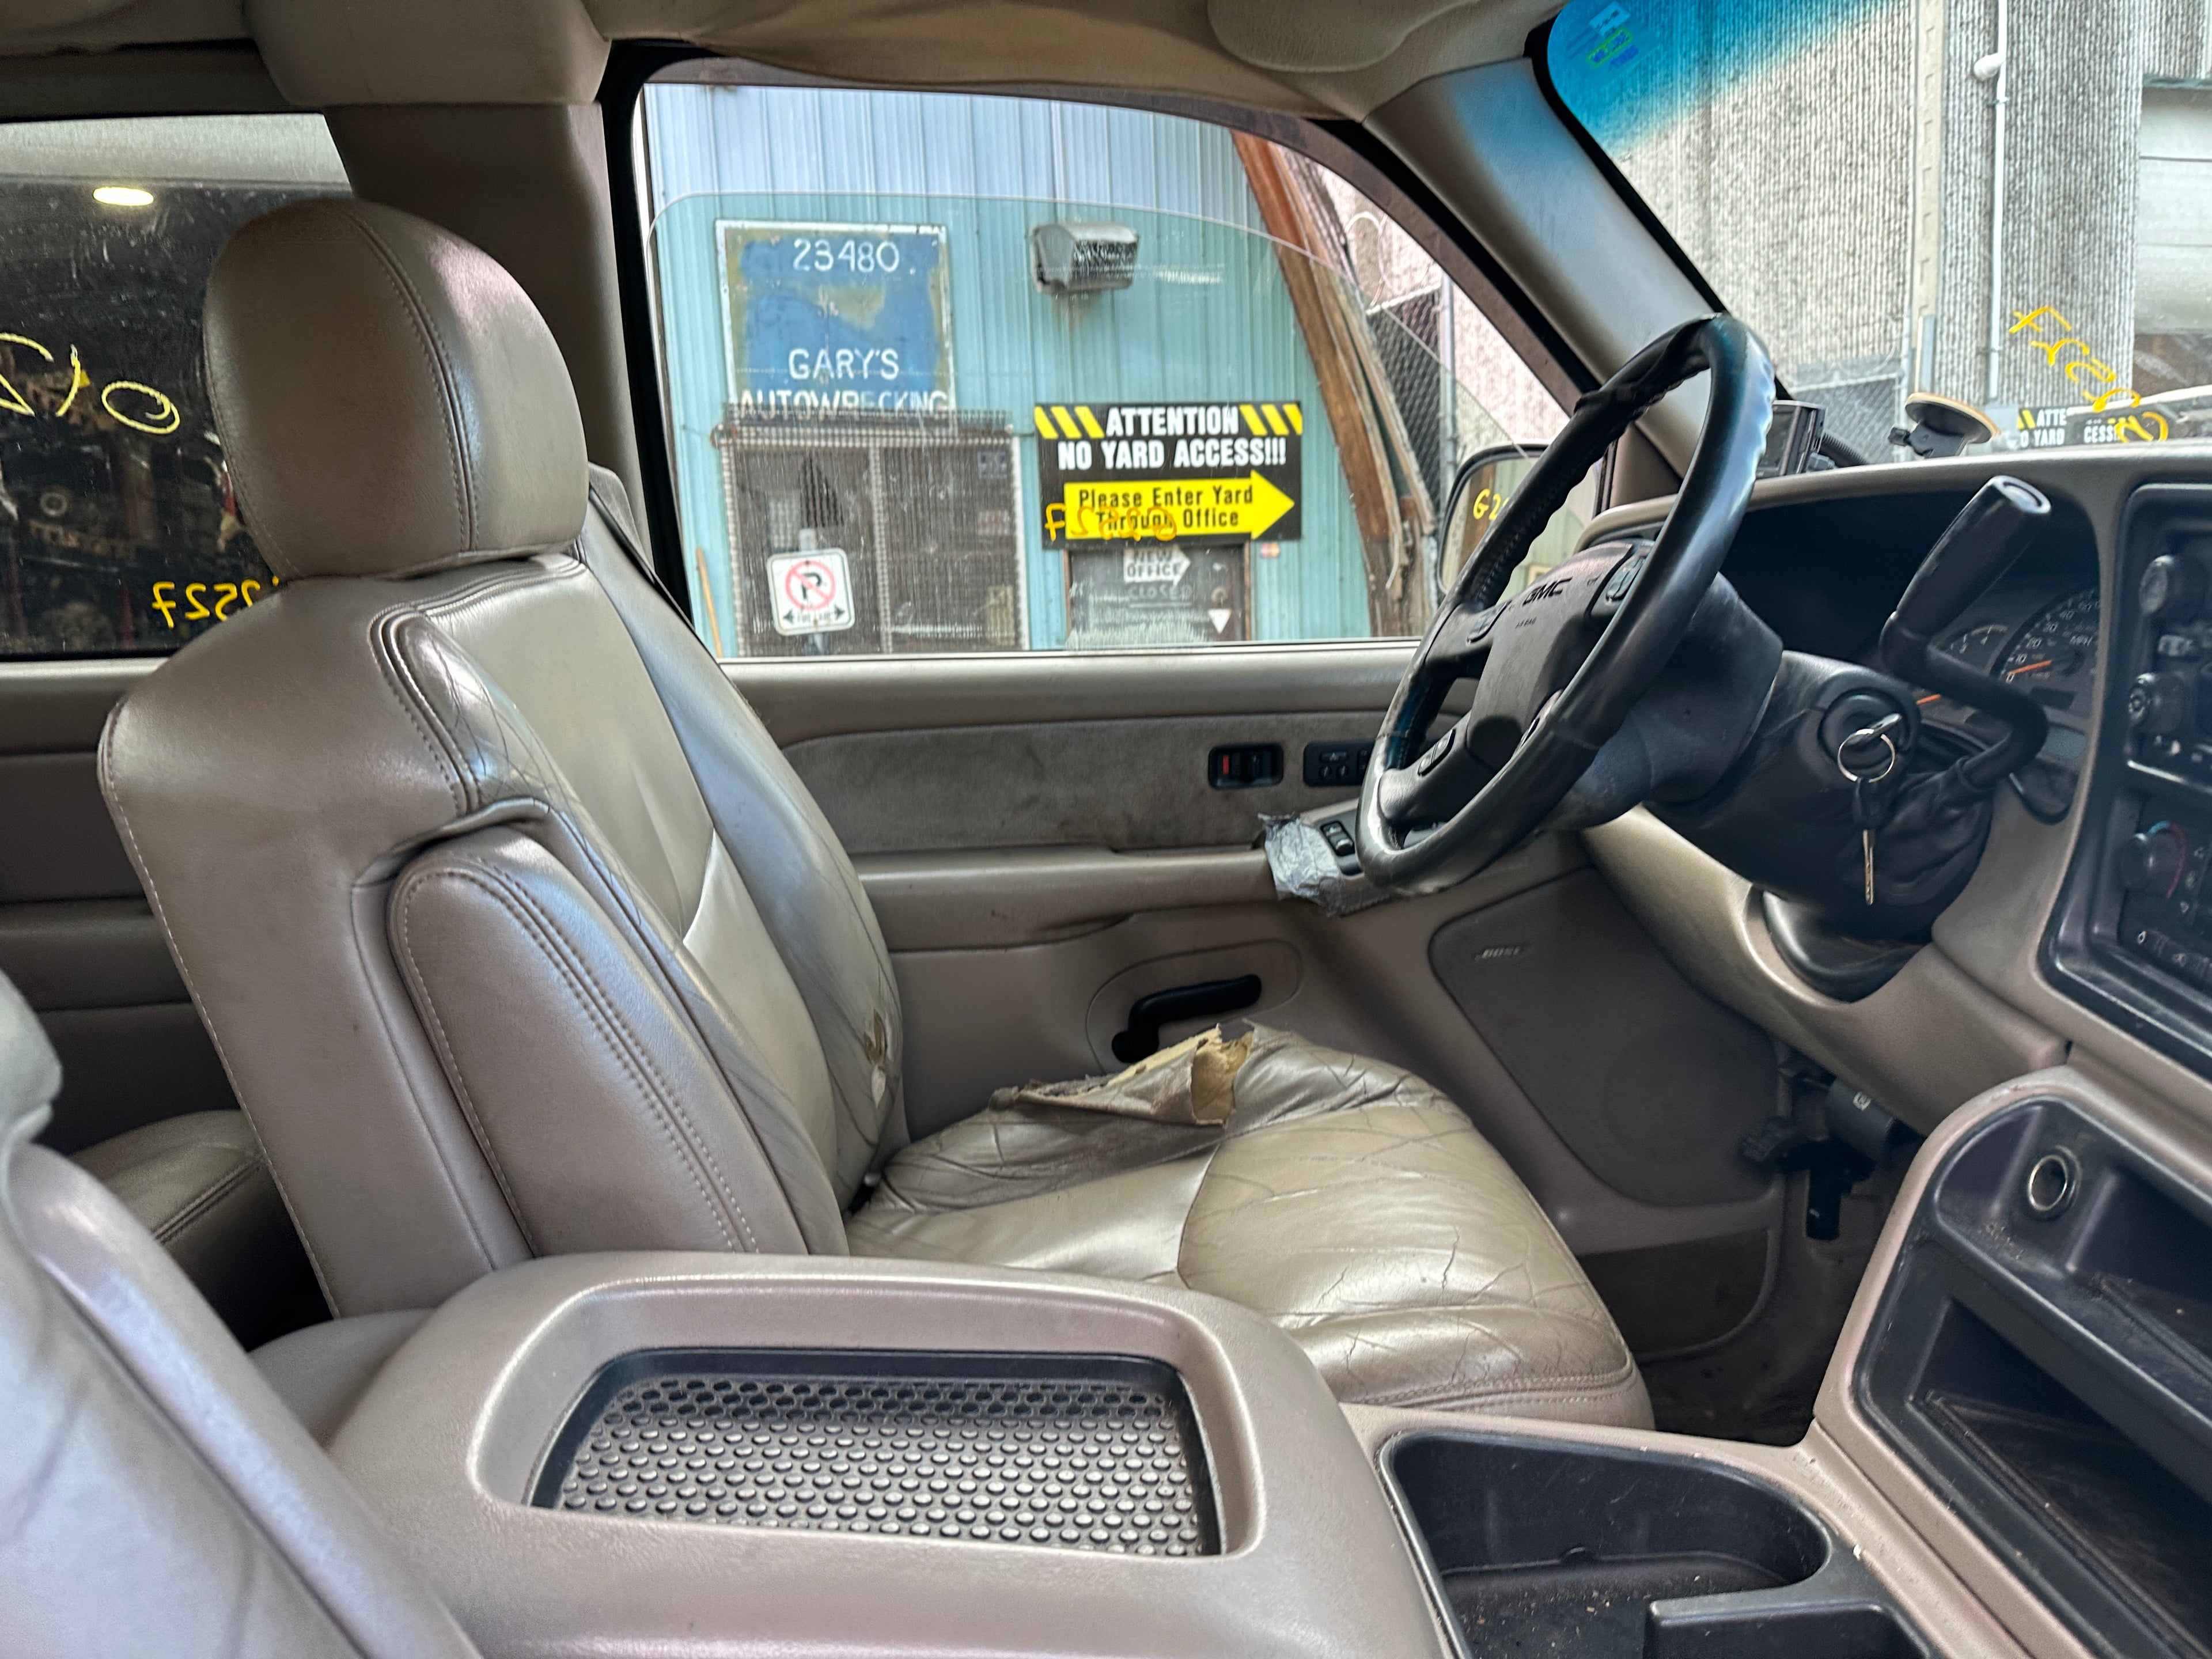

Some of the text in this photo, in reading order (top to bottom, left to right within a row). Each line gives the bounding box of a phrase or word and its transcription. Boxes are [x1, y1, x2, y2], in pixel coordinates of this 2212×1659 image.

[793, 238, 900, 272] 23480
[788, 349, 899, 380] GARY'S
[1105, 406, 1239, 437] ATTENTION
[2033, 428, 2065, 447] YARD
[1058, 437, 1286, 469] NO YARD ACCESS!!!
[1079, 484, 1253, 507] Please Enter Yard
[1096, 508, 1238, 531] Through Office
[1127, 562, 1181, 577] OFFICE
[1522, 577, 1572, 605] GMC
